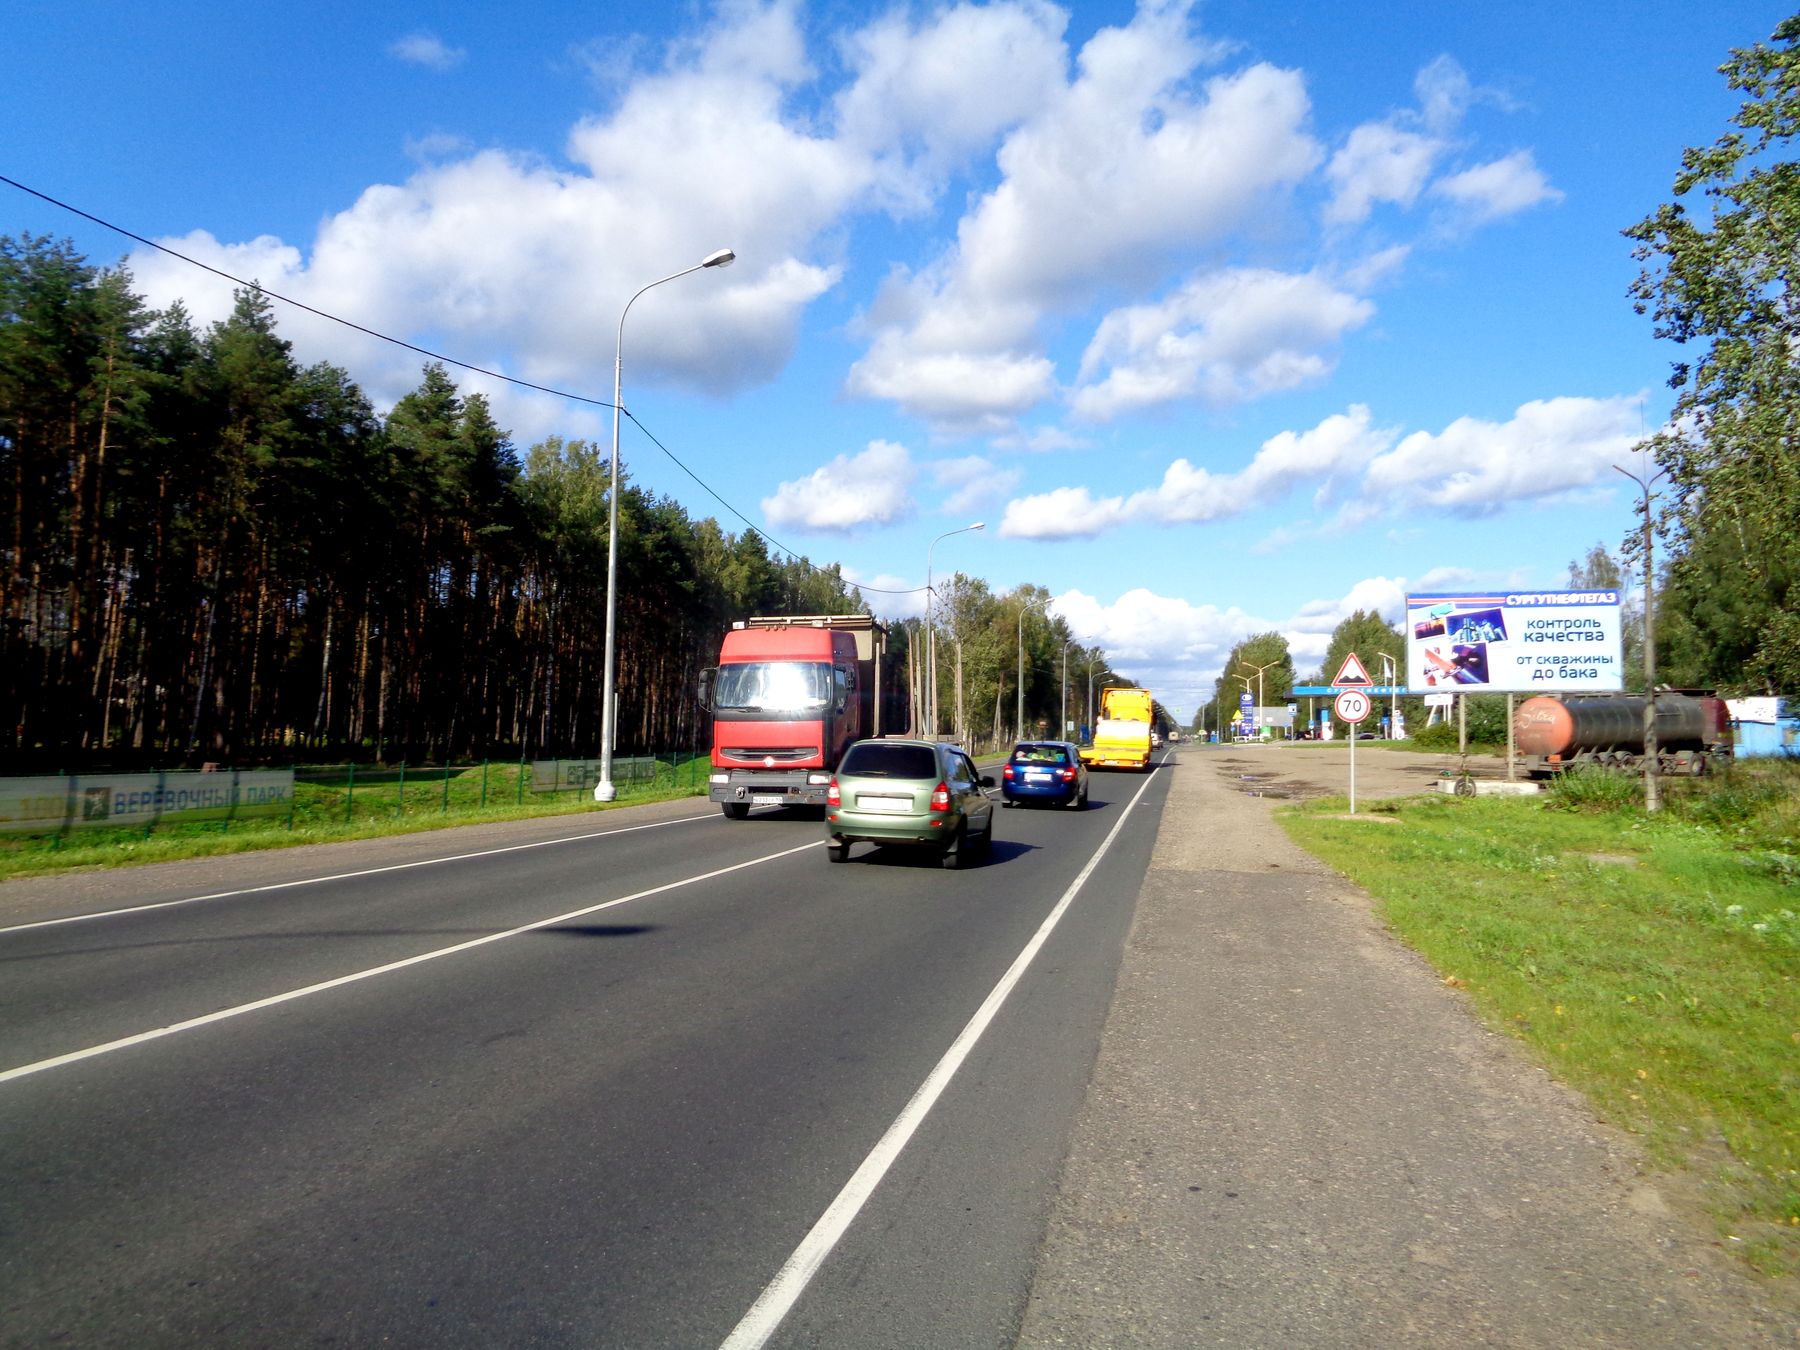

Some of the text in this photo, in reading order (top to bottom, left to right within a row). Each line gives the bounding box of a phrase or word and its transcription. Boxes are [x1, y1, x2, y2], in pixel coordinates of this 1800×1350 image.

[1505, 592, 1616, 605] СУРГУТНЕФТЕГАЗ
[1527, 619, 1601, 631] контроль
[1524, 630, 1605, 642] качества
[1516, 655, 1613, 665] от скважины
[1532, 665, 1598, 681] до бака
[1343, 699, 1362, 713] 70
[247, 786, 287, 804] ПАРК
